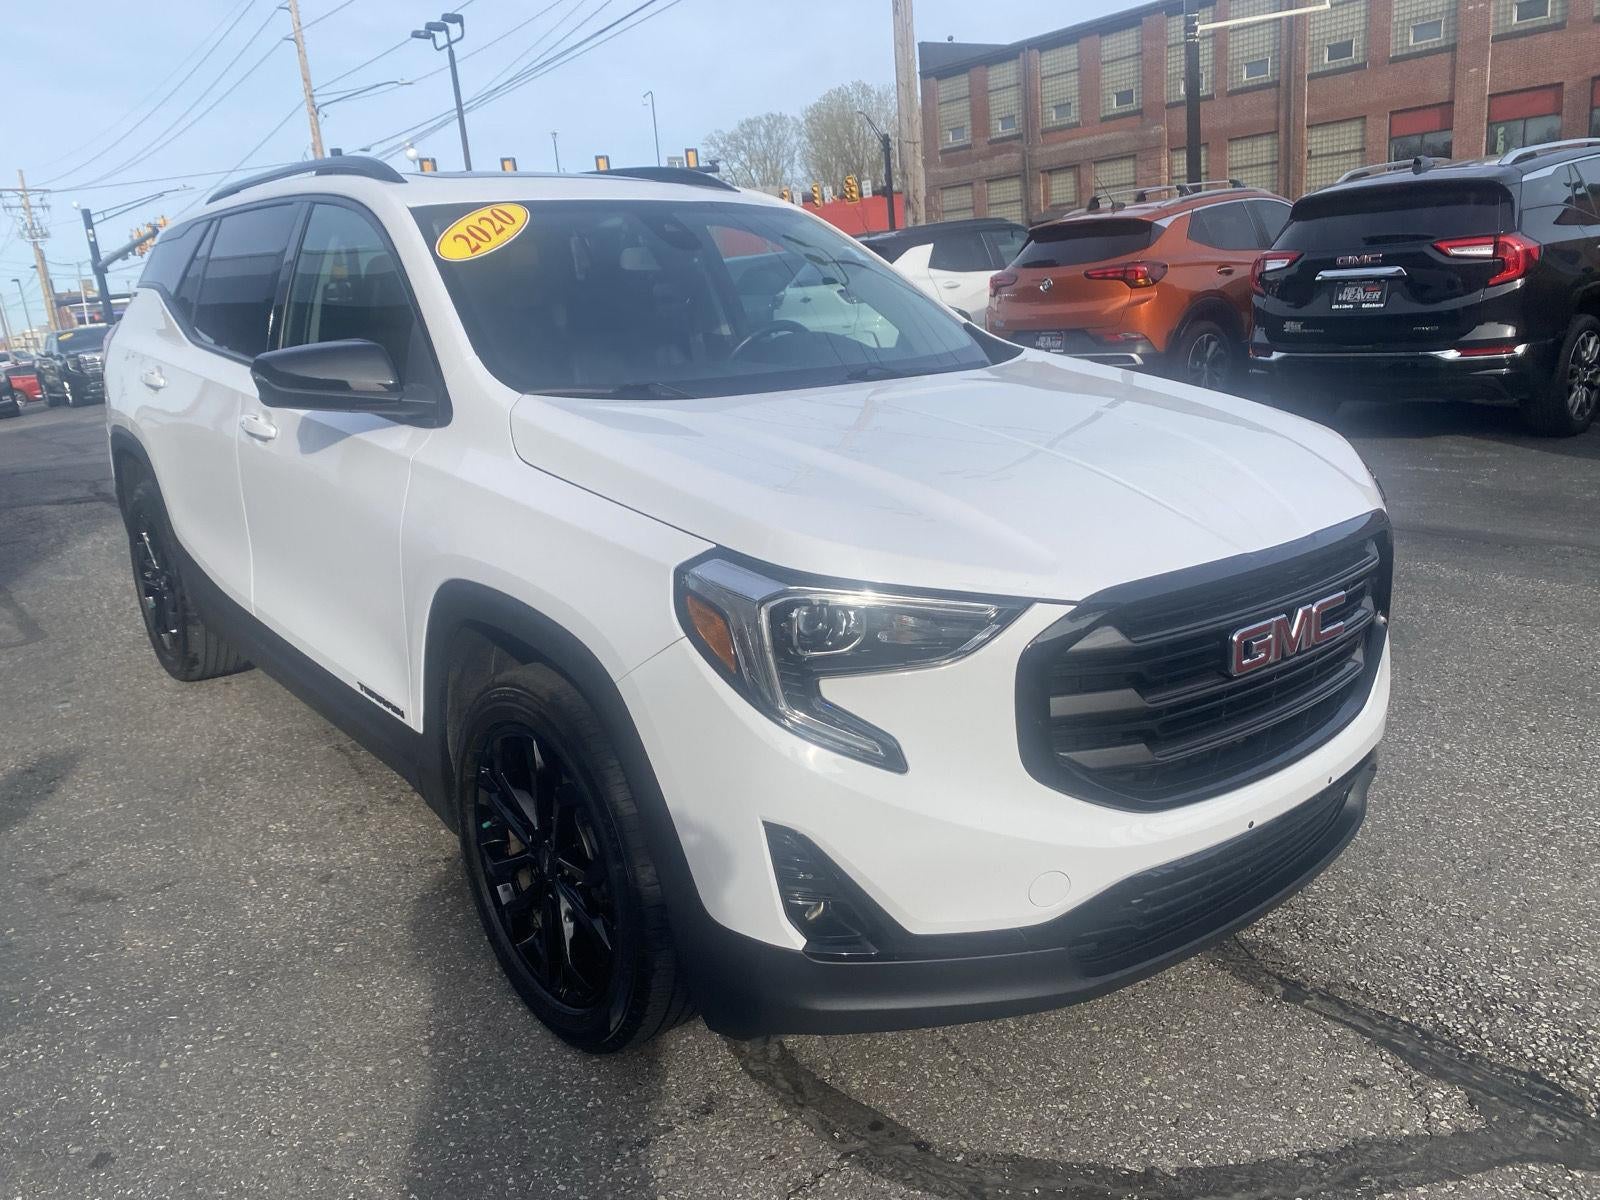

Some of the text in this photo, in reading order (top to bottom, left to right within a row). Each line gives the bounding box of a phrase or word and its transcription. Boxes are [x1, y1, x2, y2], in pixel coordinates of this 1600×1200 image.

[453, 208, 516, 254] 2020
[1336, 253, 1382, 265] GMC
[1338, 291, 1382, 301] WEAVER
[1232, 590, 1347, 677] GMC
